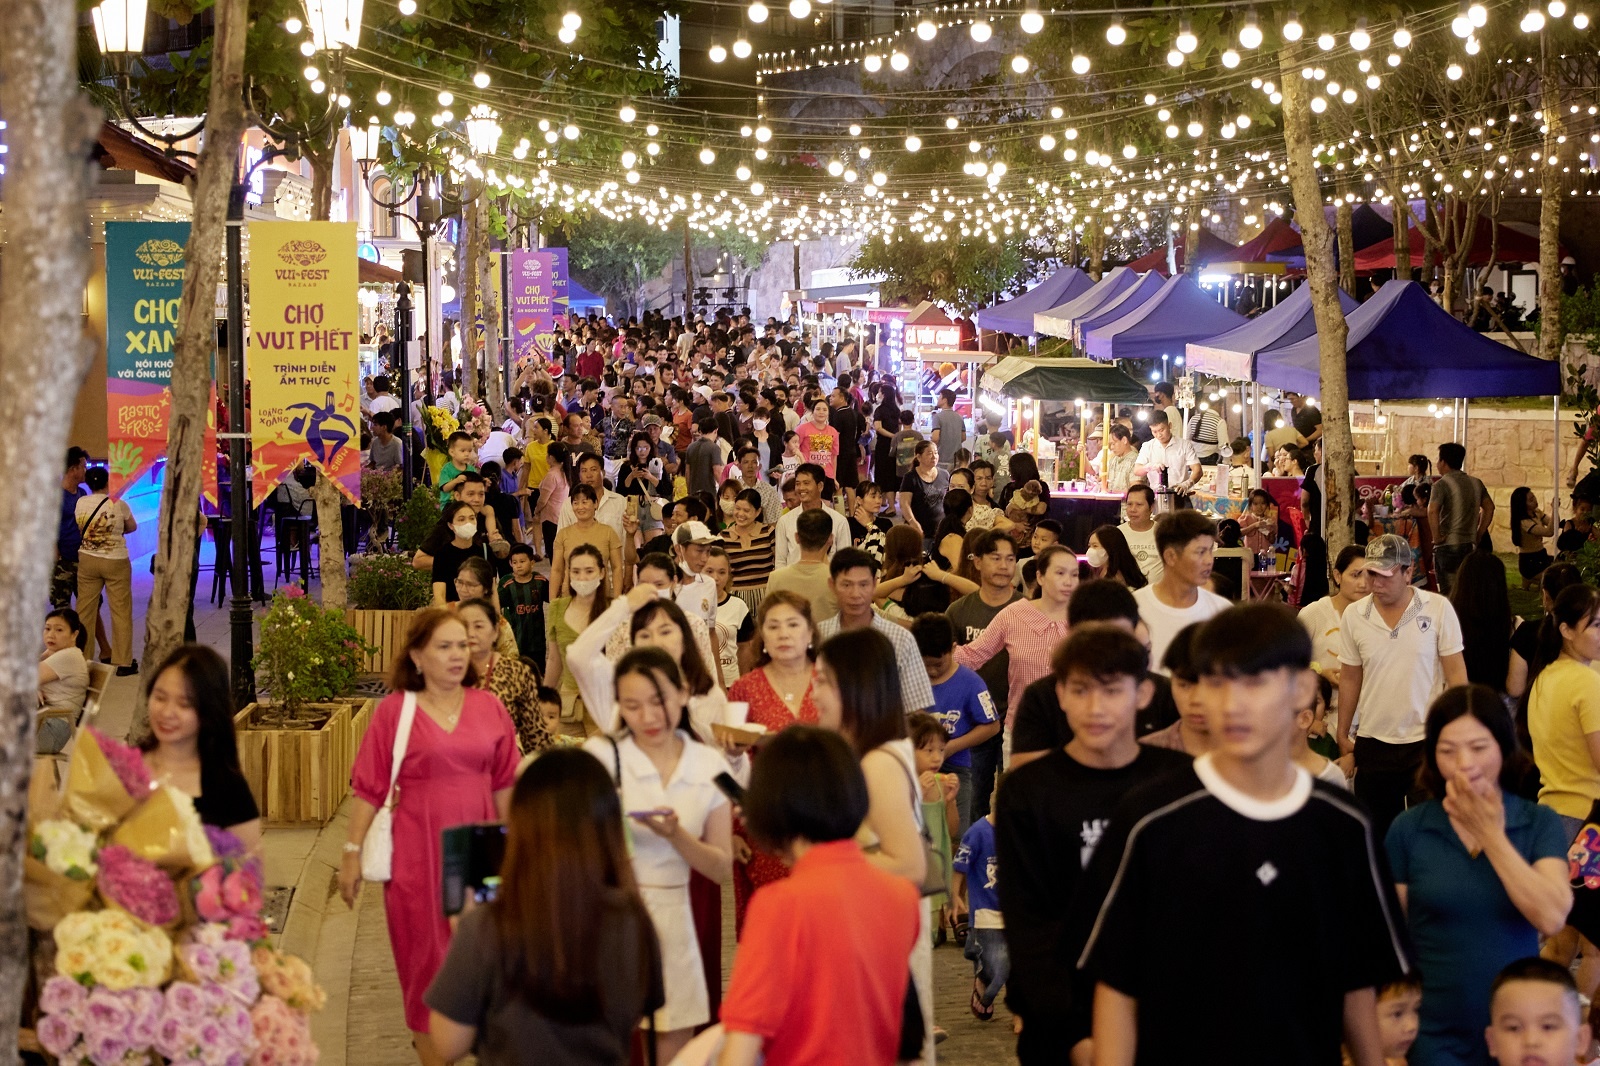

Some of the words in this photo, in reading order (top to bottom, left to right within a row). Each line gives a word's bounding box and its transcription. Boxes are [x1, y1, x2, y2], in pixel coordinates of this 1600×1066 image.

[275, 269, 329, 280] VUI-FEST
[516, 296, 530, 304] VUI
[284, 303, 324, 328] CHỢ
[126, 330, 176, 354] XAN
[256, 331, 295, 350] VUI
[300, 328, 353, 351] PHẾT
[135, 359, 152, 368] NÓI
[154, 359, 174, 368] KHÔ
[273, 362, 307, 373] TRÌNH
[310, 361, 337, 373] DIỄN
[117, 369, 134, 378] VỚI
[136, 367, 157, 378] ỐNG
[158, 369, 172, 378] HÚ
[299, 376, 330, 387] THỰC
